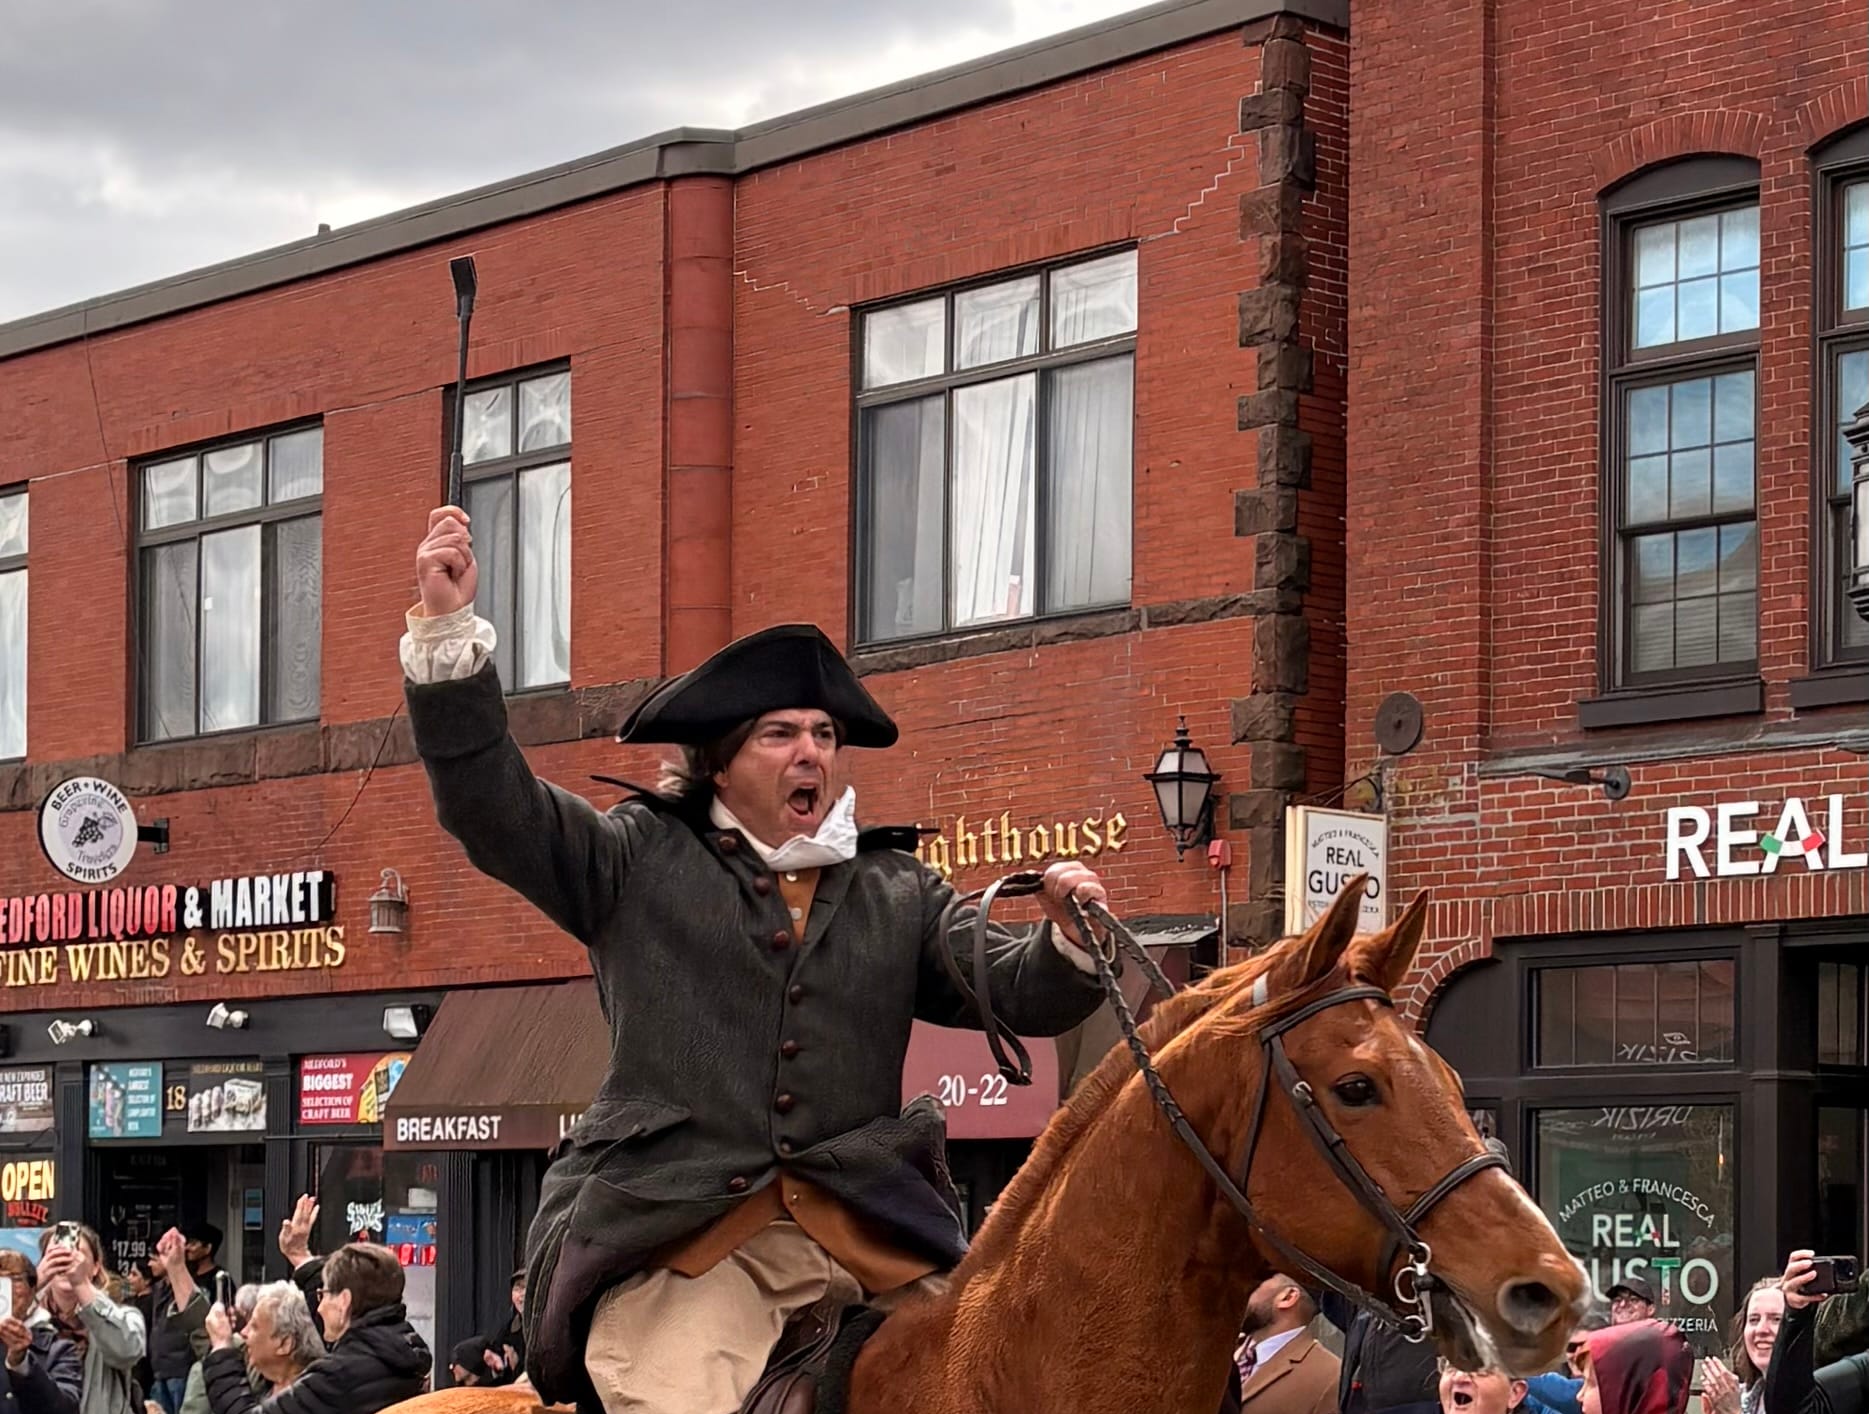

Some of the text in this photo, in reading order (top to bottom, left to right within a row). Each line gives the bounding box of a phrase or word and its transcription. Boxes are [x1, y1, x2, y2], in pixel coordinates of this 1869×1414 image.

[51, 781, 128, 814] BEER WINE
[915, 811, 1128, 881] ighthouse
[1666, 793, 1868, 880] REAL
[66, 862, 117, 880] SPIRITS
[1326, 847, 1365, 868] REAL
[1308, 869, 1381, 899] GUO
[88, 885, 178, 941] LIQUOR
[183, 886, 203, 929] &
[211, 871, 324, 930] MARKET
[66, 938, 171, 982] WINES
[180, 937, 206, 975] &
[216, 926, 346, 973] SPIRITS
[166, 1085, 186, 1110] 18
[303, 1073, 354, 1091] BIGGEST
[938, 1073, 1008, 1107] 20-22
[397, 1115, 502, 1141] BREAKFAST
[1, 1160, 55, 1201] OPEN
[1559, 1178, 1715, 1228] MATTEO & FRANCESCA
[1592, 1213, 1680, 1248] REAL
[1591, 1257, 1719, 1305] USTO
